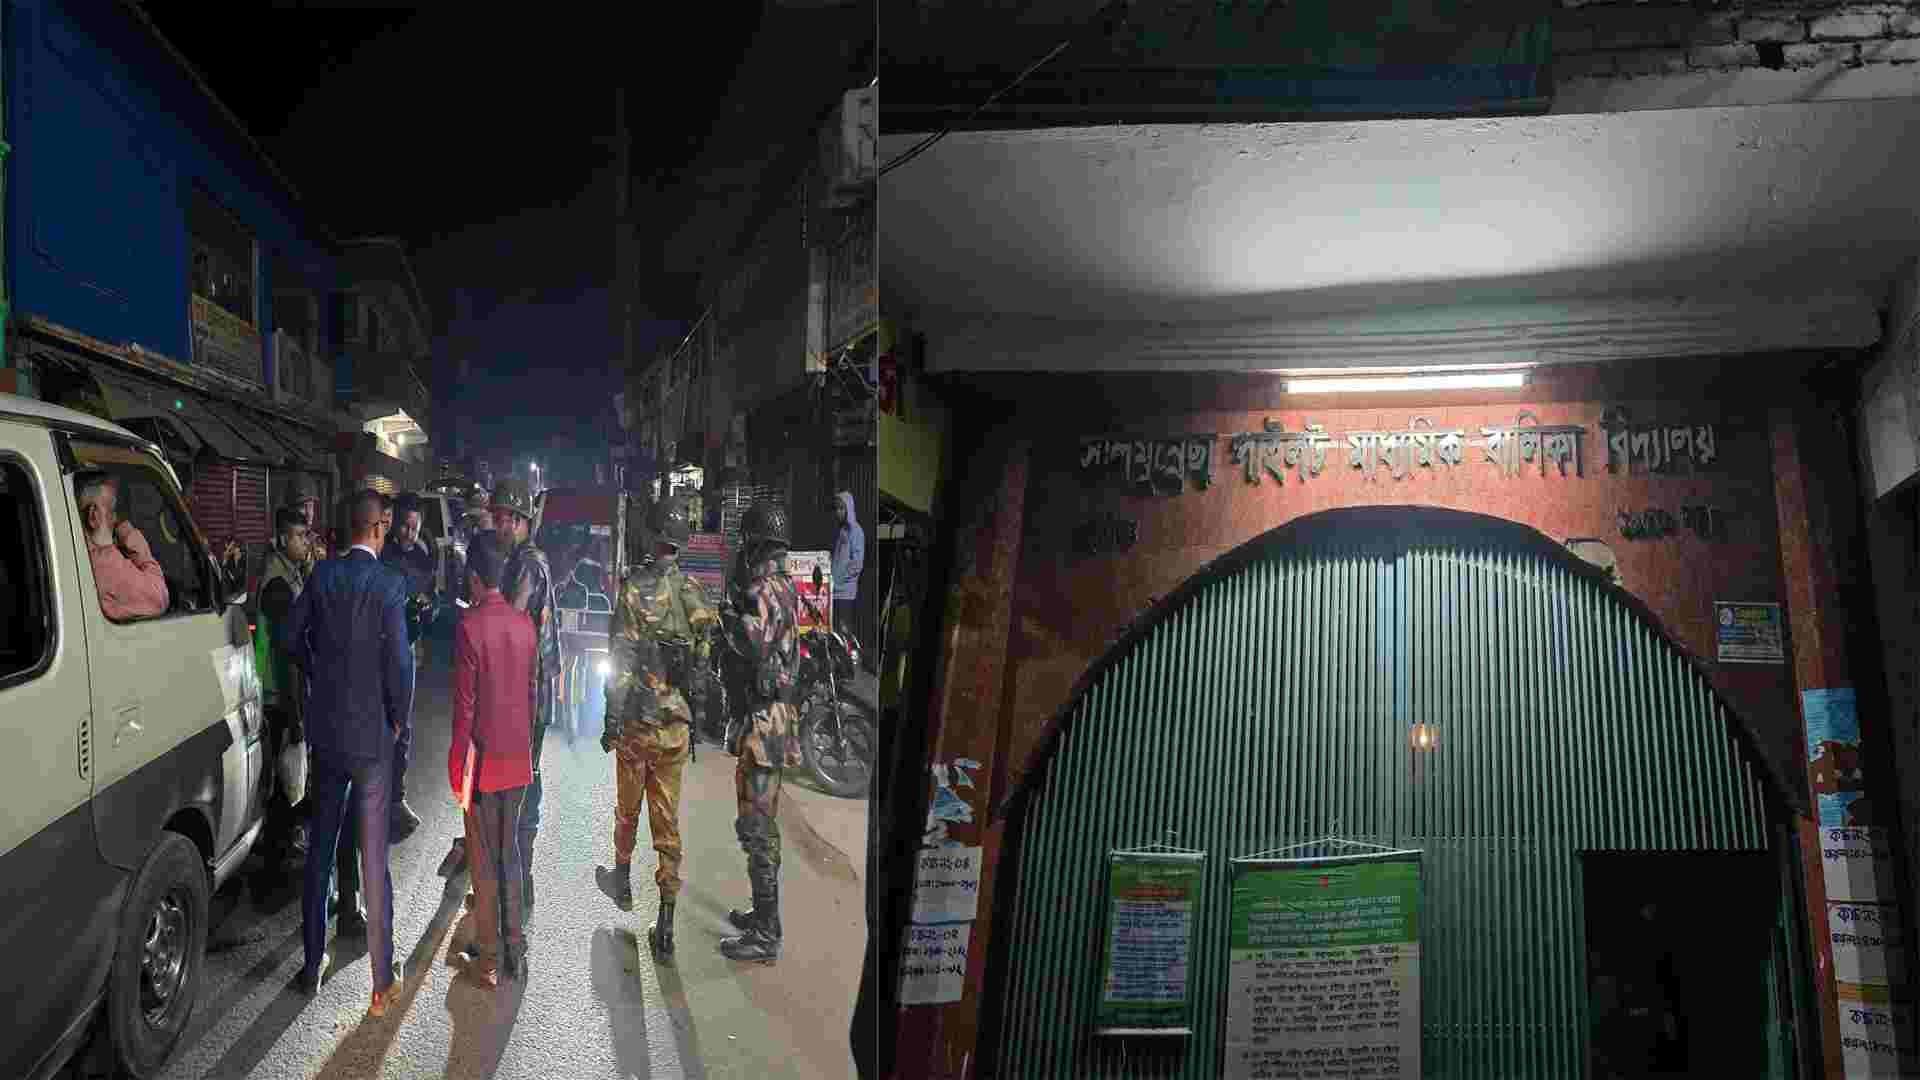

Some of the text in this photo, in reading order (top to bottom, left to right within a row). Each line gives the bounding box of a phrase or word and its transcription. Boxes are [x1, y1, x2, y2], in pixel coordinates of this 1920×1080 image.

[1231, 417, 1329, 486] পাইলট
[1349, 415, 1463, 482] মাধ্যমিক
[1480, 409, 1584, 477] বালিকা
[1600, 407, 1717, 472] বিদ্যালয়
